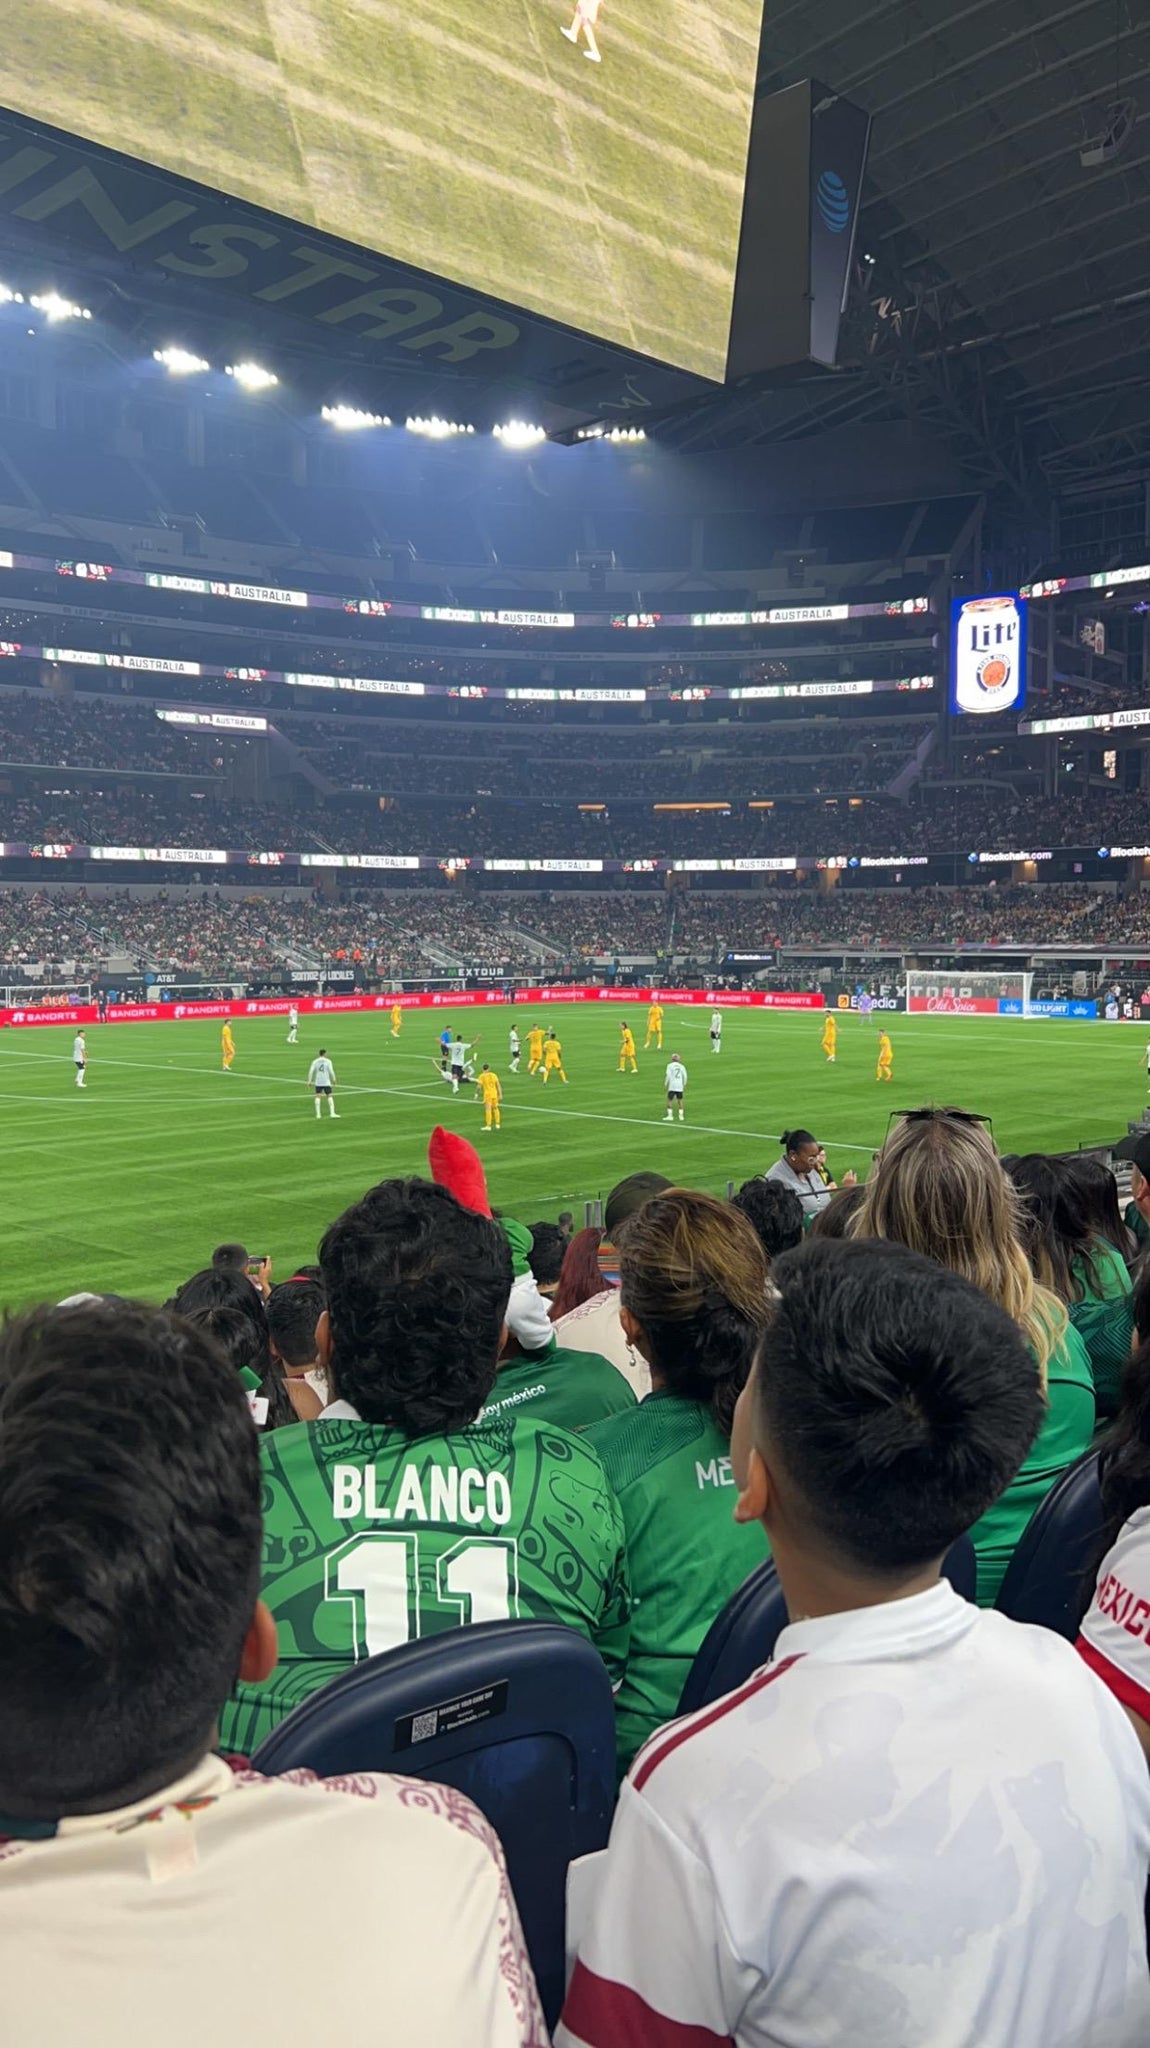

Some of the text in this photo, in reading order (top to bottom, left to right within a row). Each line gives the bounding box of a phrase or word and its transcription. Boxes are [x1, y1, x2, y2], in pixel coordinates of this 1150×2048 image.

[0, 140, 521, 362] INSTAR
[210, 581, 229, 596] VS.
[234, 586, 292, 602] AUSTRALIA
[503, 613, 559, 624] AUSTRALIA
[774, 609, 833, 622] AUSTRALIA
[971, 622, 1016, 653] Lite
[128, 659, 185, 672] AUSTRALIA
[359, 681, 410, 692] AUSTRALIA
[805, 683, 858, 695] AUSTRALIA
[580, 691, 631, 700] AUSTRALIA
[215, 717, 256, 727] AUSTRALIA
[164, 851, 214, 861] AUSTRALIA
[979, 851, 1052, 862] Blockchain.com
[364, 857, 408, 868] AUSTRALIA
[547, 861, 591, 870] AUSTRALIA
[739, 859, 784, 869] AUSTRALIA
[861, 856, 928, 867] Blockchain.com
[447, 967, 505, 977] MEXTOUR
[616, 966, 633, 974] AT&T
[156, 974, 177, 983] AT&T
[442, 994, 475, 1003] BANORTE
[608, 991, 639, 999] BANORTE
[664, 993, 694, 1001] BANORTE
[716, 994, 751, 1003] BANORTE
[324, 1000, 362, 1009] BANORTE
[385, 997, 420, 1006] BANORTE
[774, 996, 812, 1005] BANORTE
[927, 997, 976, 1013] Old Spice
[110, 1009, 158, 1018] BANORTE
[187, 1005, 231, 1015] BANORTE
[1043, 1004, 1067, 1013] LIGHT
[27, 1012, 78, 1022] BANORTE
[319, 1063, 324, 1073] 4
[675, 1067, 681, 1079] 2
[501, 1384, 546, 1410] méxico
[333, 1464, 512, 1525] BLANCO
[325, 1531, 520, 1665] 11
